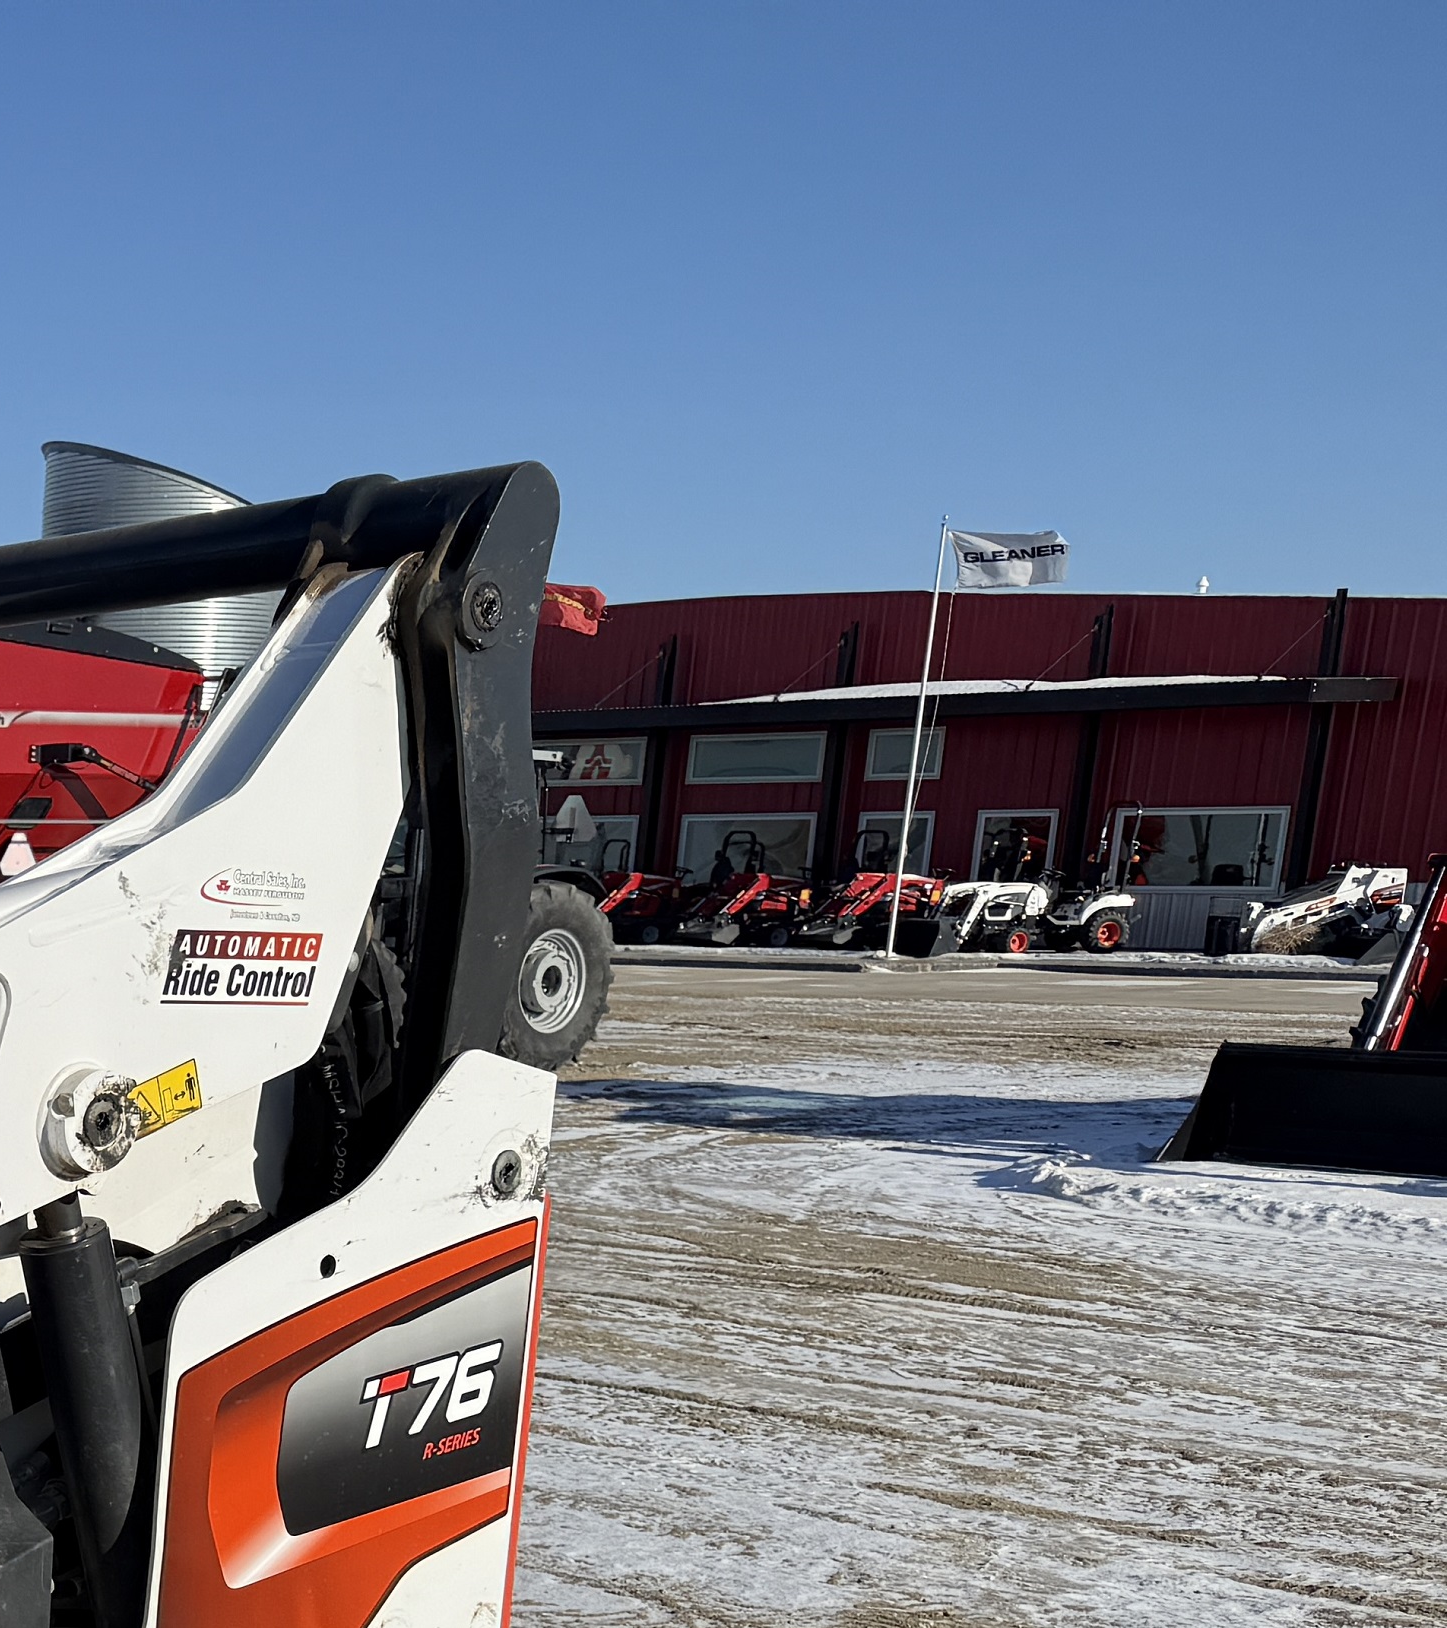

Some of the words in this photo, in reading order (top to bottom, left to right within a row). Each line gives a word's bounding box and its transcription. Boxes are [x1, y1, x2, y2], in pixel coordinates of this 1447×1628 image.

[963, 543, 1065, 563] GLEANER
[178, 933, 318, 959] AUTOMATIC
[162, 960, 221, 998] Ride
[225, 963, 317, 998] Control
[362, 1341, 504, 1450] T76
[422, 1427, 482, 1461] R-SERIES
